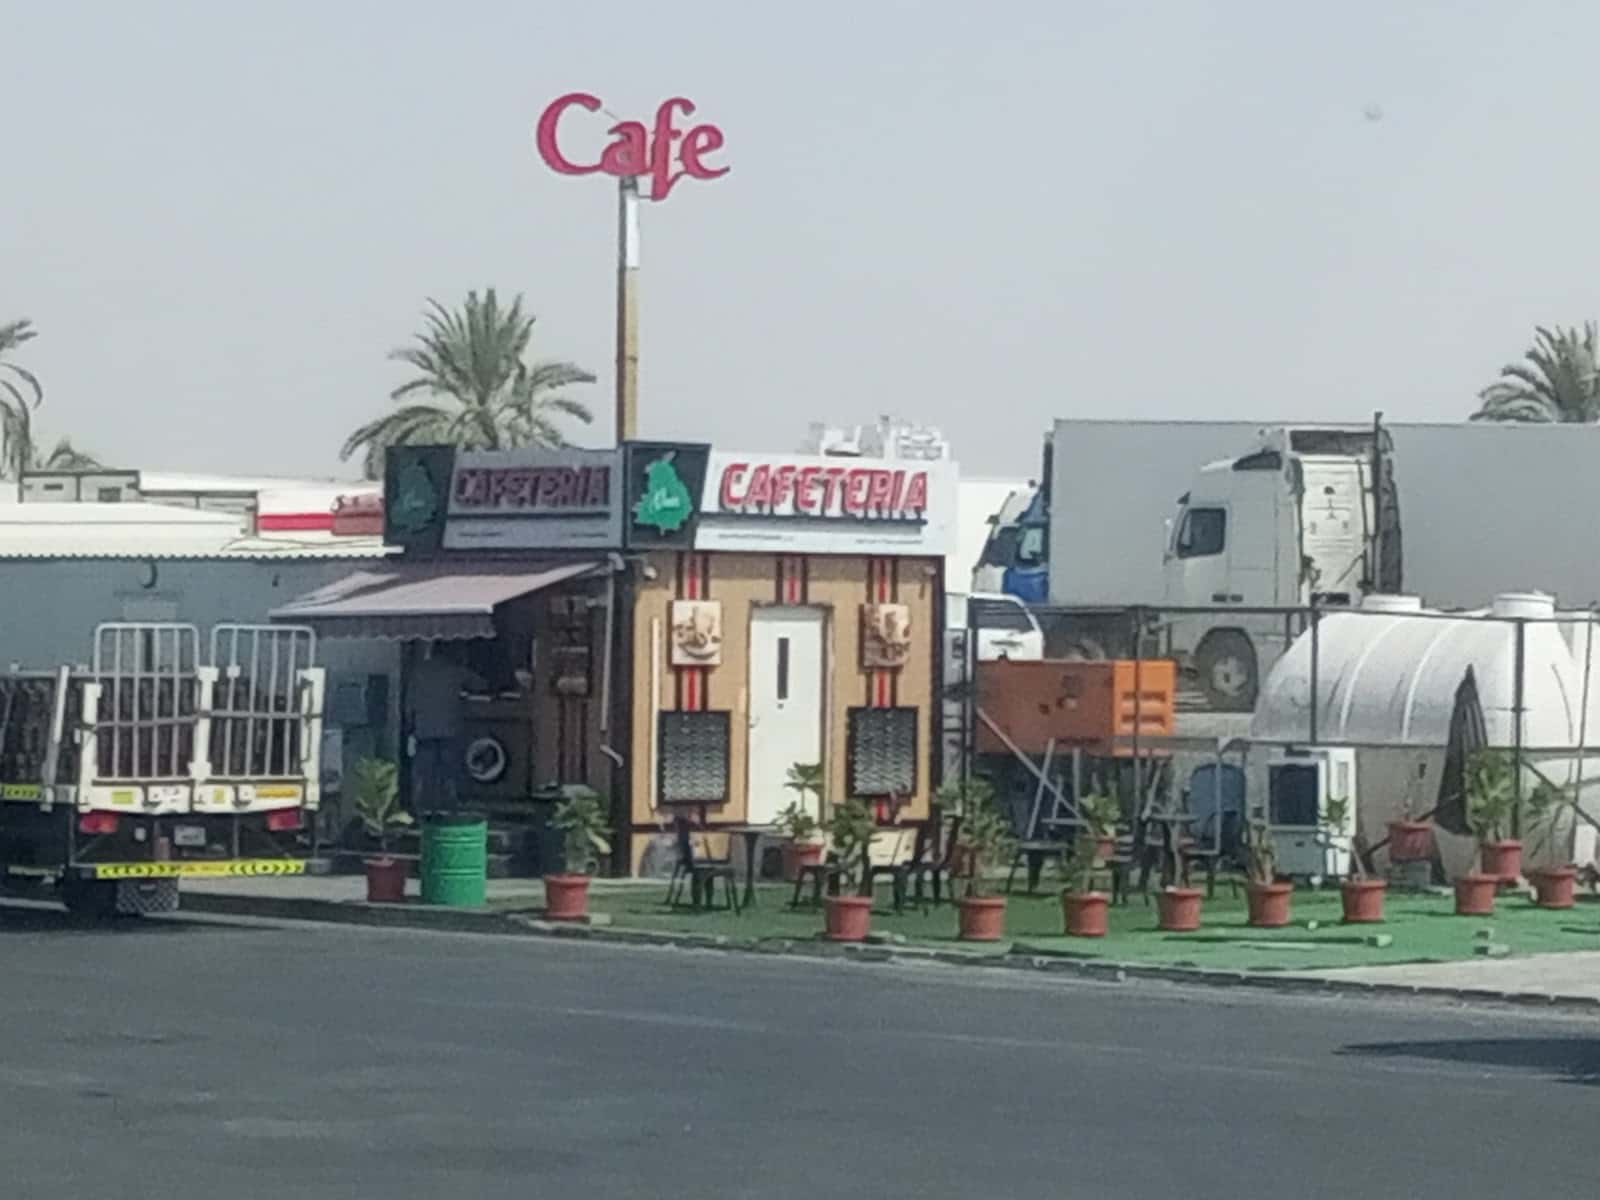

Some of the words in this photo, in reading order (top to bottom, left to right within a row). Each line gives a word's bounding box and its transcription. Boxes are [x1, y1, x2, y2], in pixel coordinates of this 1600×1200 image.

[536, 91, 731, 201] Cafe
[456, 465, 610, 507] CAFETERIA
[719, 462, 928, 517] CAFETERIA
